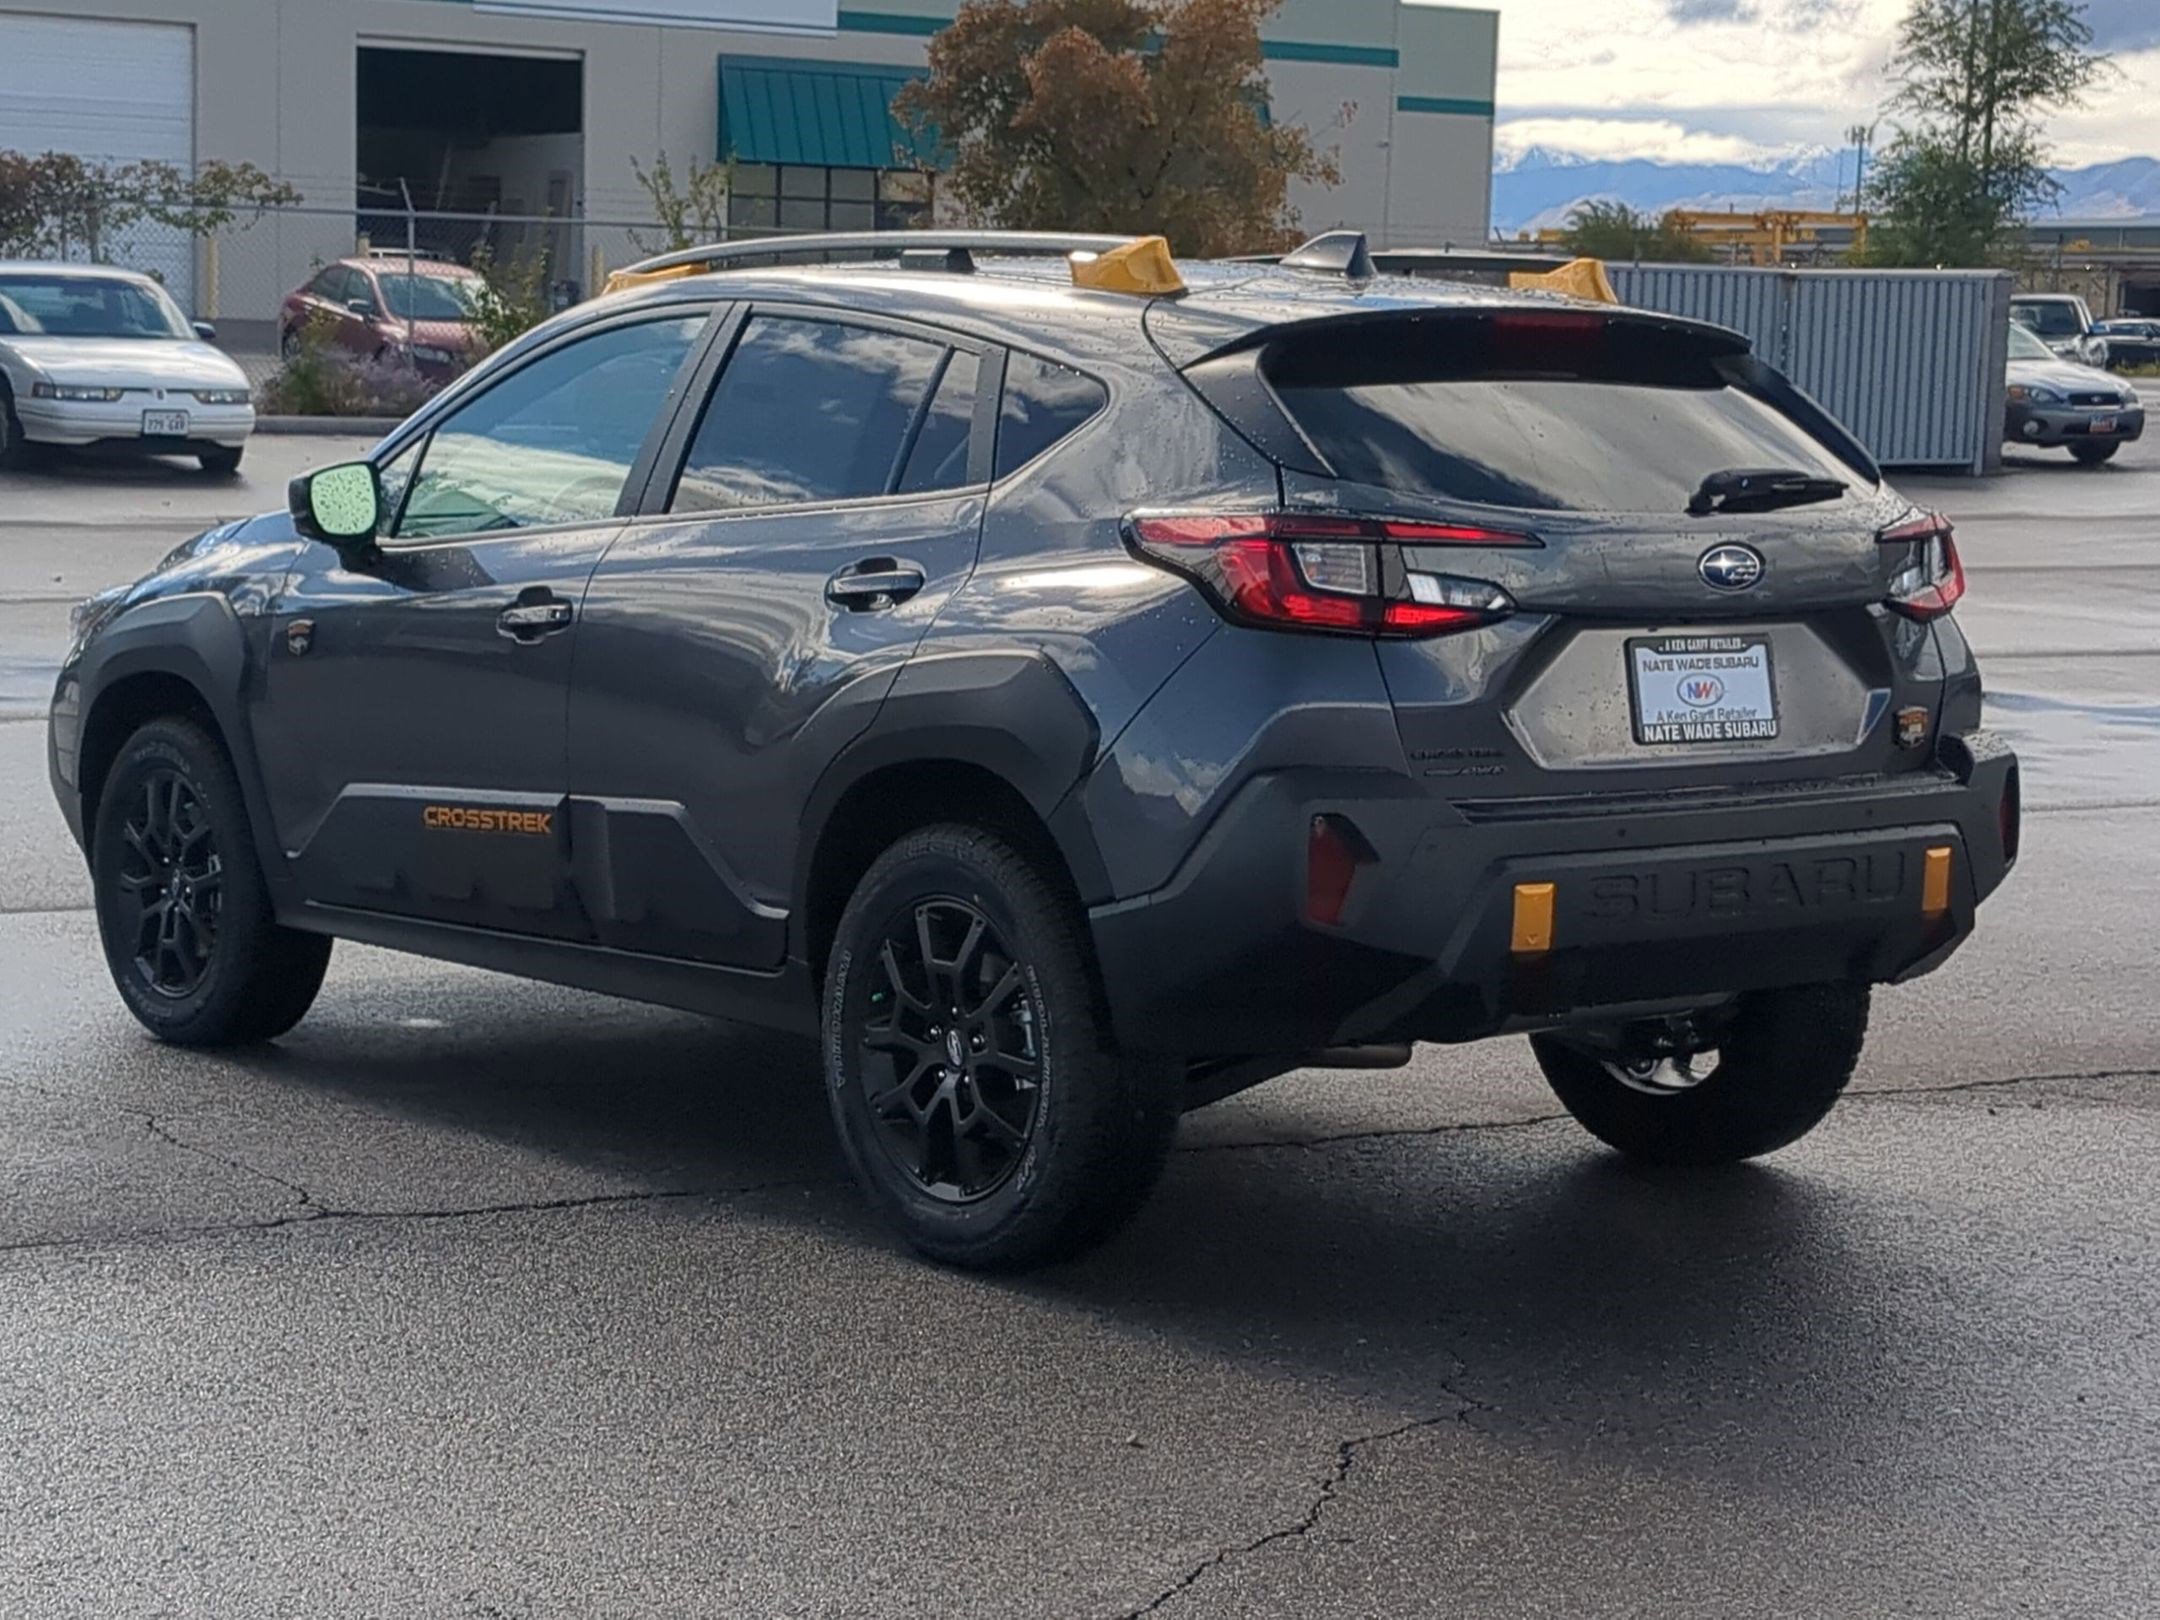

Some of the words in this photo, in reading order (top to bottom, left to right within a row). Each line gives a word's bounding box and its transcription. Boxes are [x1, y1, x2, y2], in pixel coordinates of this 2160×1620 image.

[1665, 639, 1670, 651] A
[1671, 638, 1686, 651] KEN
[1710, 637, 1741, 649] RETAILER
[1643, 659, 1675, 672] NATE
[1677, 657, 1712, 671] WADE
[1713, 656, 1759, 670] SUBARU
[1656, 711, 1665, 723] A
[1666, 709, 1688, 721] Ken
[1717, 706, 1757, 721] Retailer
[1644, 724, 1681, 742] NATE
[1683, 722, 1723, 741] WADE
[1724, 719, 1777, 739] SUBARU
[424, 806, 552, 833] CROSSTREK
[1588, 850, 1906, 918] SUBARU
